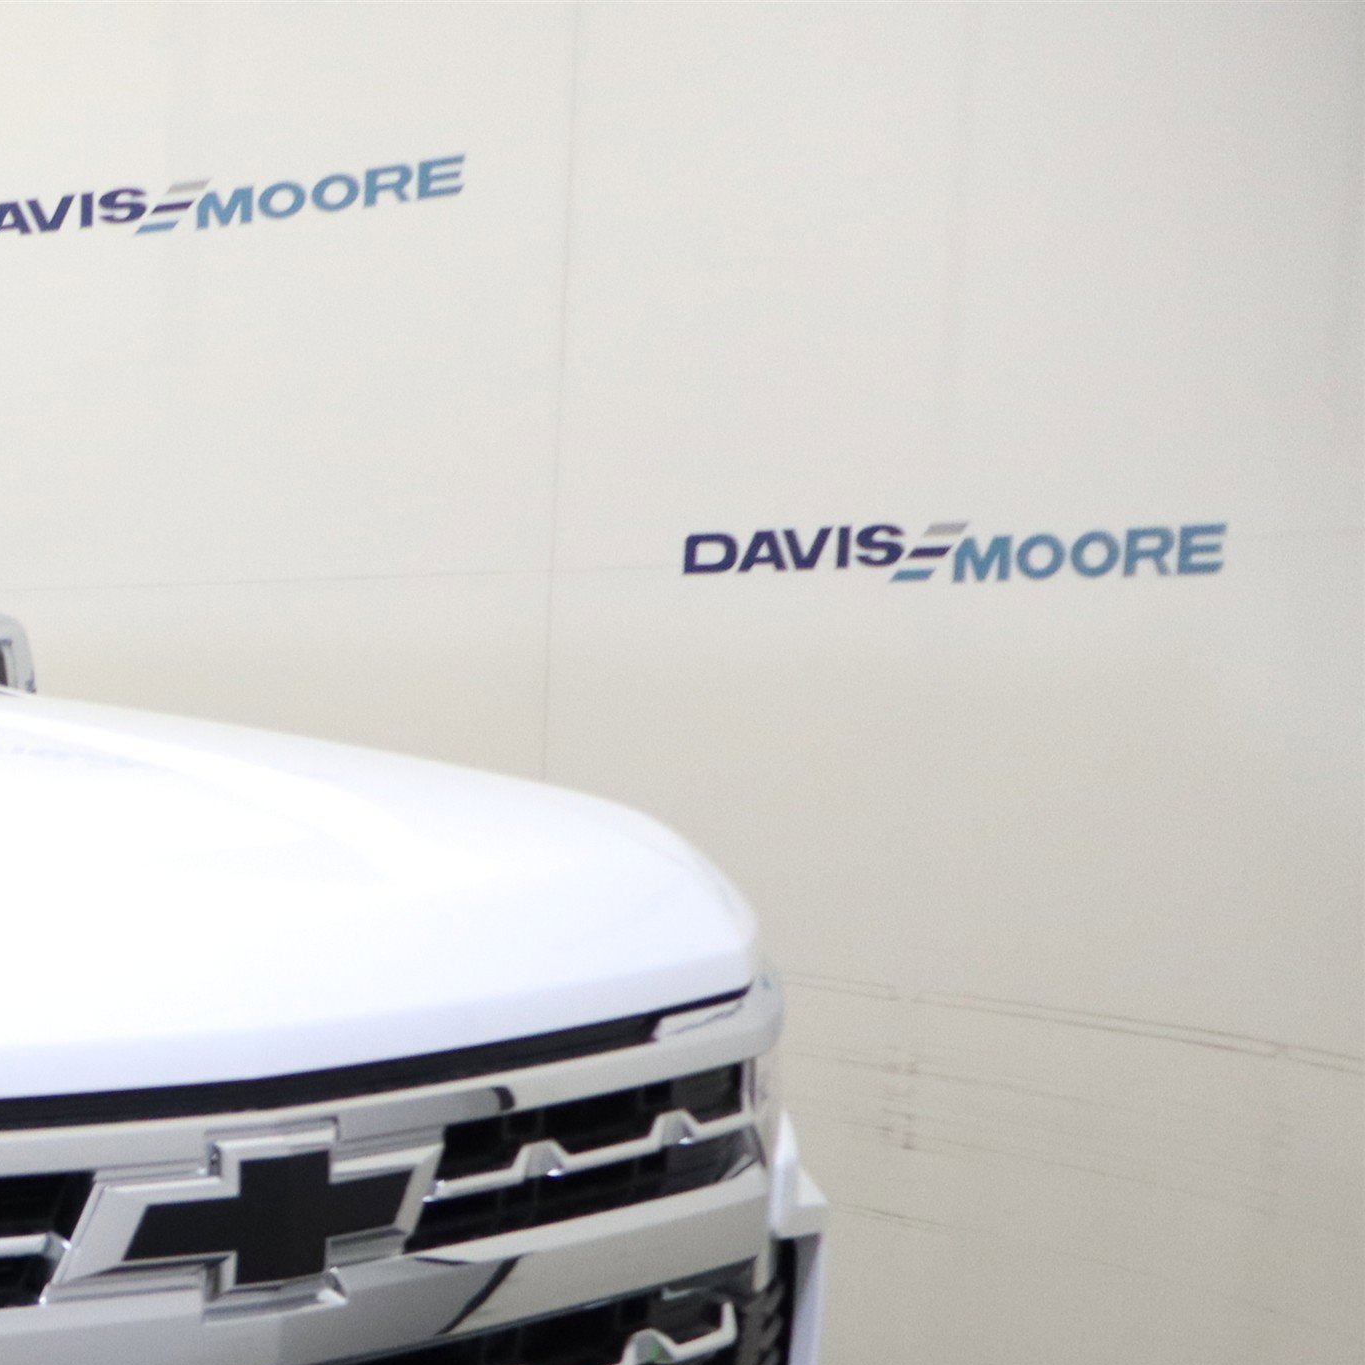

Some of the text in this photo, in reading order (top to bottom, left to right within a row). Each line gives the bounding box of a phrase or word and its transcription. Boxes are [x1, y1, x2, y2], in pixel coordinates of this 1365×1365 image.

[196, 154, 465, 231] MOORE
[682, 522, 1228, 584] DAVIS MOORE
